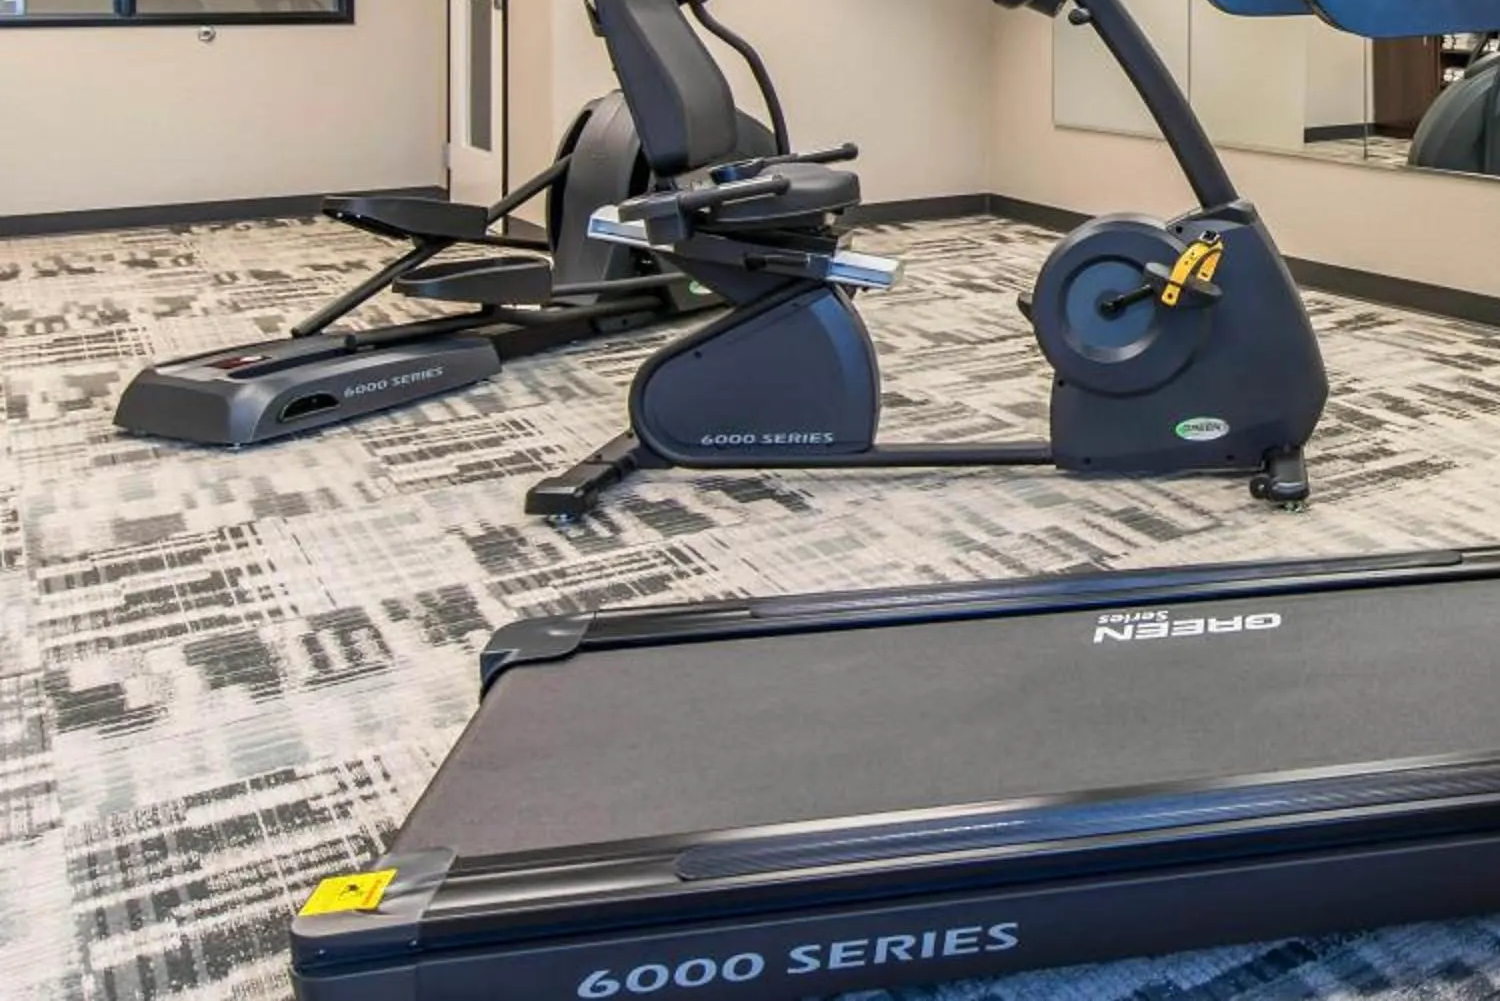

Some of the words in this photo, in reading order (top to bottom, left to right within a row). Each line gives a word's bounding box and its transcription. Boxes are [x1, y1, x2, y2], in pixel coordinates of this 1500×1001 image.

[343, 379, 388, 398] 6000
[391, 366, 443, 387] SERIES
[701, 433, 755, 446] 6000
[760, 432, 834, 444] SERIES
[1093, 612, 1282, 644] GREEN
[1097, 610, 1169, 624] Series
[577, 952, 765, 999] 6000
[787, 922, 1019, 975] SERIES
